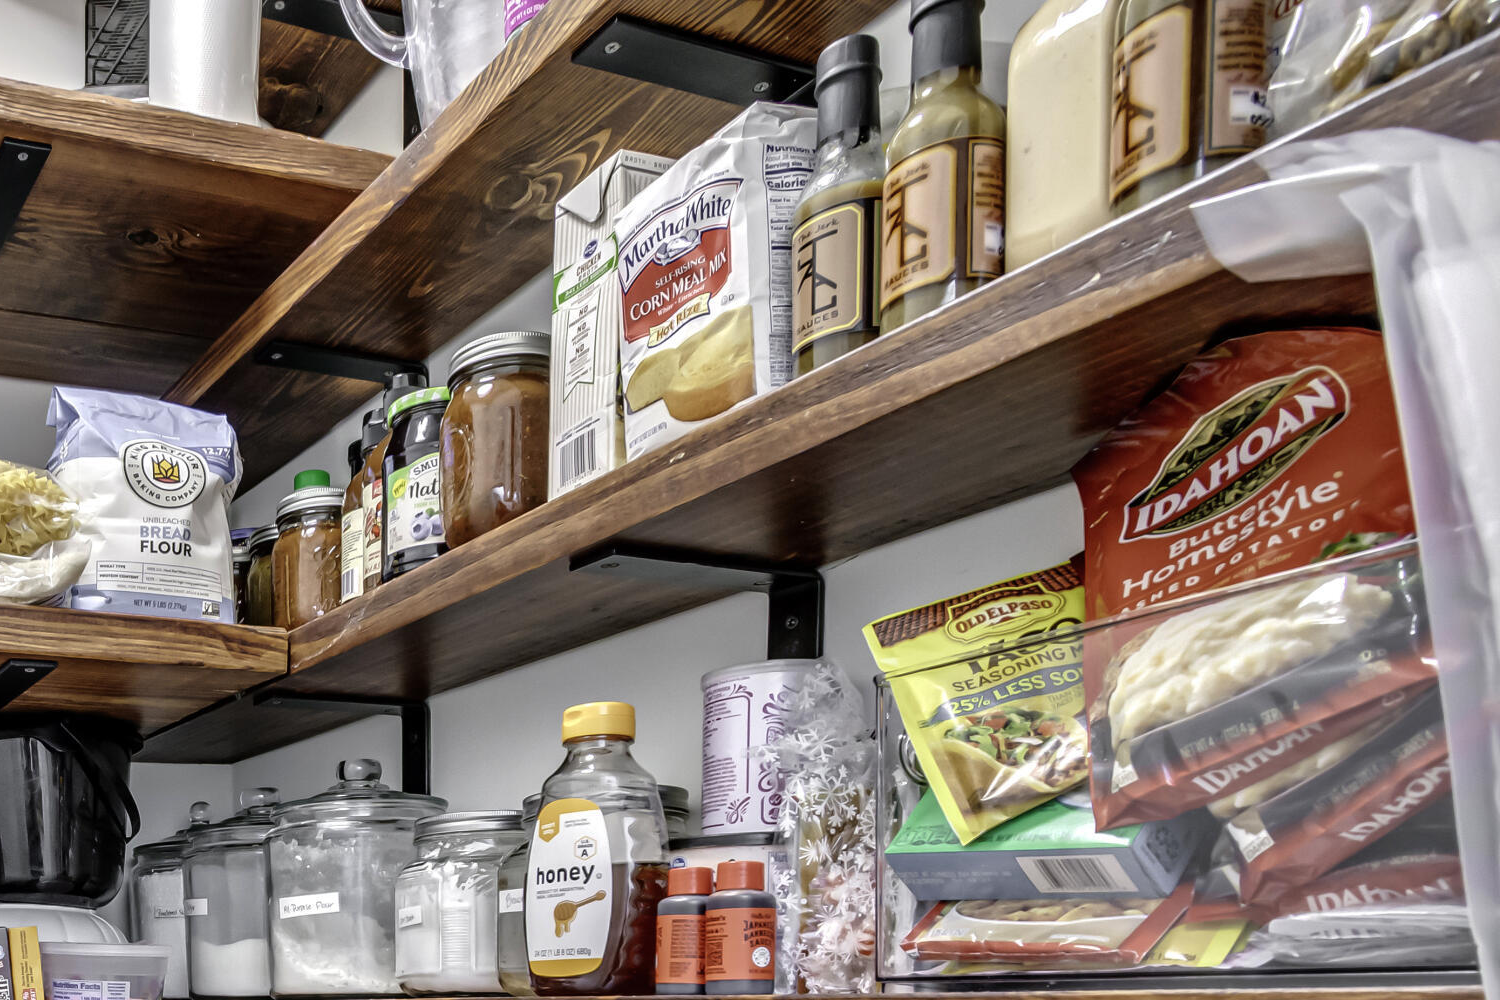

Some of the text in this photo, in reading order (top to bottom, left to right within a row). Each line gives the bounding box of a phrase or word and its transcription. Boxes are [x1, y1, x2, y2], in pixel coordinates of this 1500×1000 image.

[624, 218, 685, 282] Martha
[682, 192, 731, 228] White
[576, 251, 602, 277] CHICKEN
[655, 255, 706, 288] SELF-RISING
[630, 247, 727, 321] CORN MEAL MIX
[656, 320, 674, 341] Hot
[1133, 378, 1336, 533] IDAHOAN
[133, 473, 199, 502] BAKING COMPANY
[140, 525, 191, 541] BREAD
[143, 517, 191, 527] UNBLEACHED
[1169, 480, 1290, 559] Buttery
[140, 540, 192, 557] FLOUR
[1122, 482, 1339, 598] Homestyle
[955, 604, 1007, 633] OLD EL
[952, 647, 1066, 692] SEASONING
[950, 674, 1046, 714] 25% LESS
[581, 849, 588, 857] A
[536, 865, 595, 885] honey
[53, 981, 100, 990] Nutrition Facts
